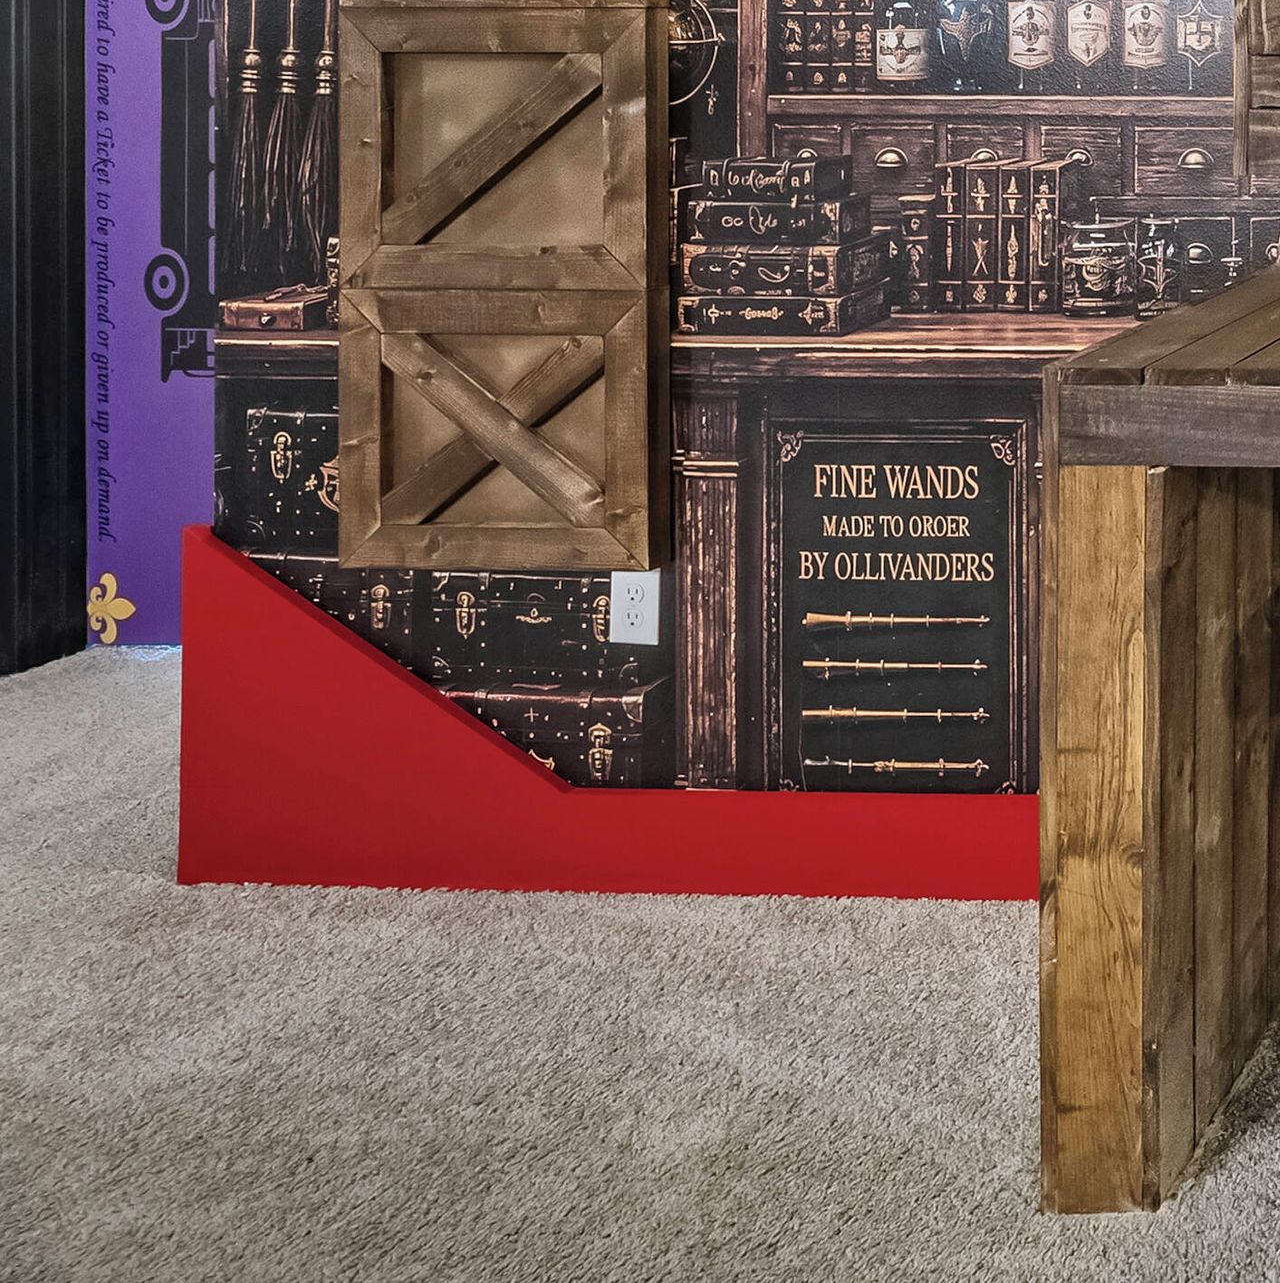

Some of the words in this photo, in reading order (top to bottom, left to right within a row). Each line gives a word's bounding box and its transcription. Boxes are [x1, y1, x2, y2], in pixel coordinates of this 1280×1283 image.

[97, 38, 110, 57] to
[97, 61, 116, 106] have
[97, 110, 109, 123] a
[92, 127, 115, 185] Ticket
[96, 191, 110, 210] to
[96, 216, 115, 236] be
[91, 240, 115, 330] produced
[96, 330, 109, 351] or
[91, 352, 112, 404] given
[91, 410, 109, 434] up
[97, 439, 109, 463] on
[813, 464, 877, 499] FINE
[883, 465, 980, 500] WANDS
[822, 515, 875, 537] MADE
[879, 515, 904, 537] TO
[798, 551, 829, 580] BY
[834, 552, 995, 582] OLLIVANDERS
